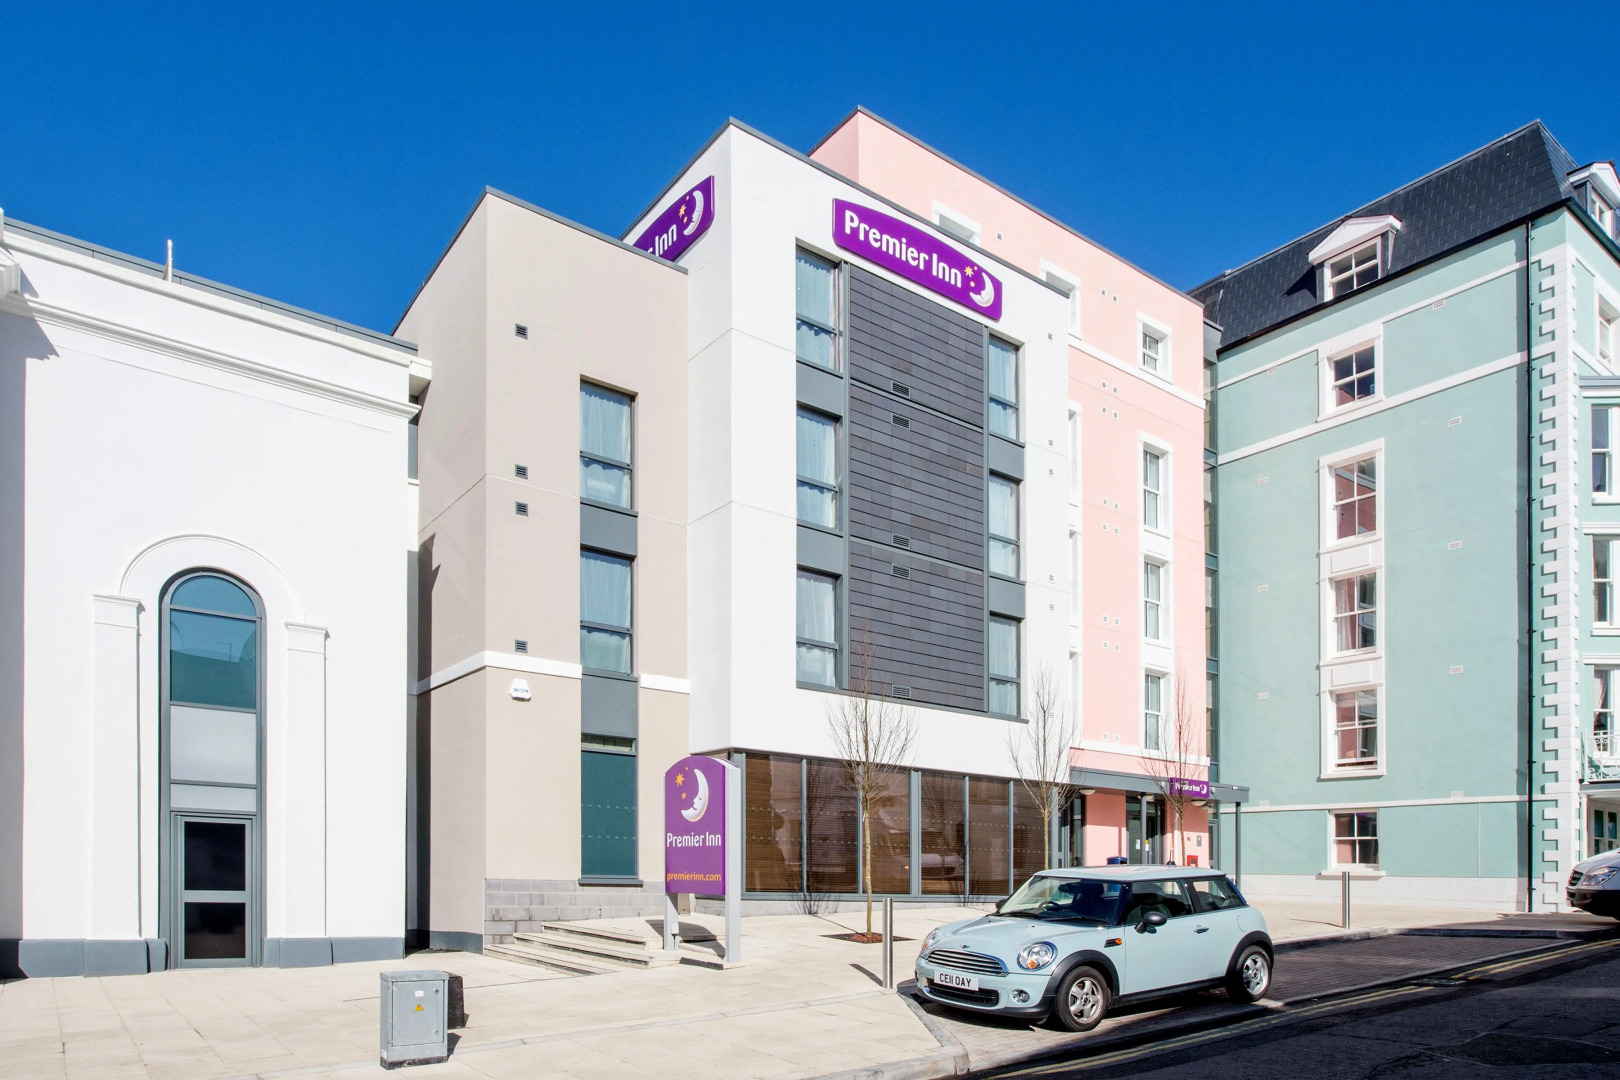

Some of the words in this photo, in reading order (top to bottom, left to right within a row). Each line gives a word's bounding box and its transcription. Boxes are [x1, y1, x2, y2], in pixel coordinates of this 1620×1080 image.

[655, 224, 677, 257] Inn
[845, 209, 929, 270] Premier
[932, 253, 962, 288] Inn
[666, 832, 704, 848] Premier
[706, 831, 721, 847] Inn
[666, 870, 722, 883] premierinn.com
